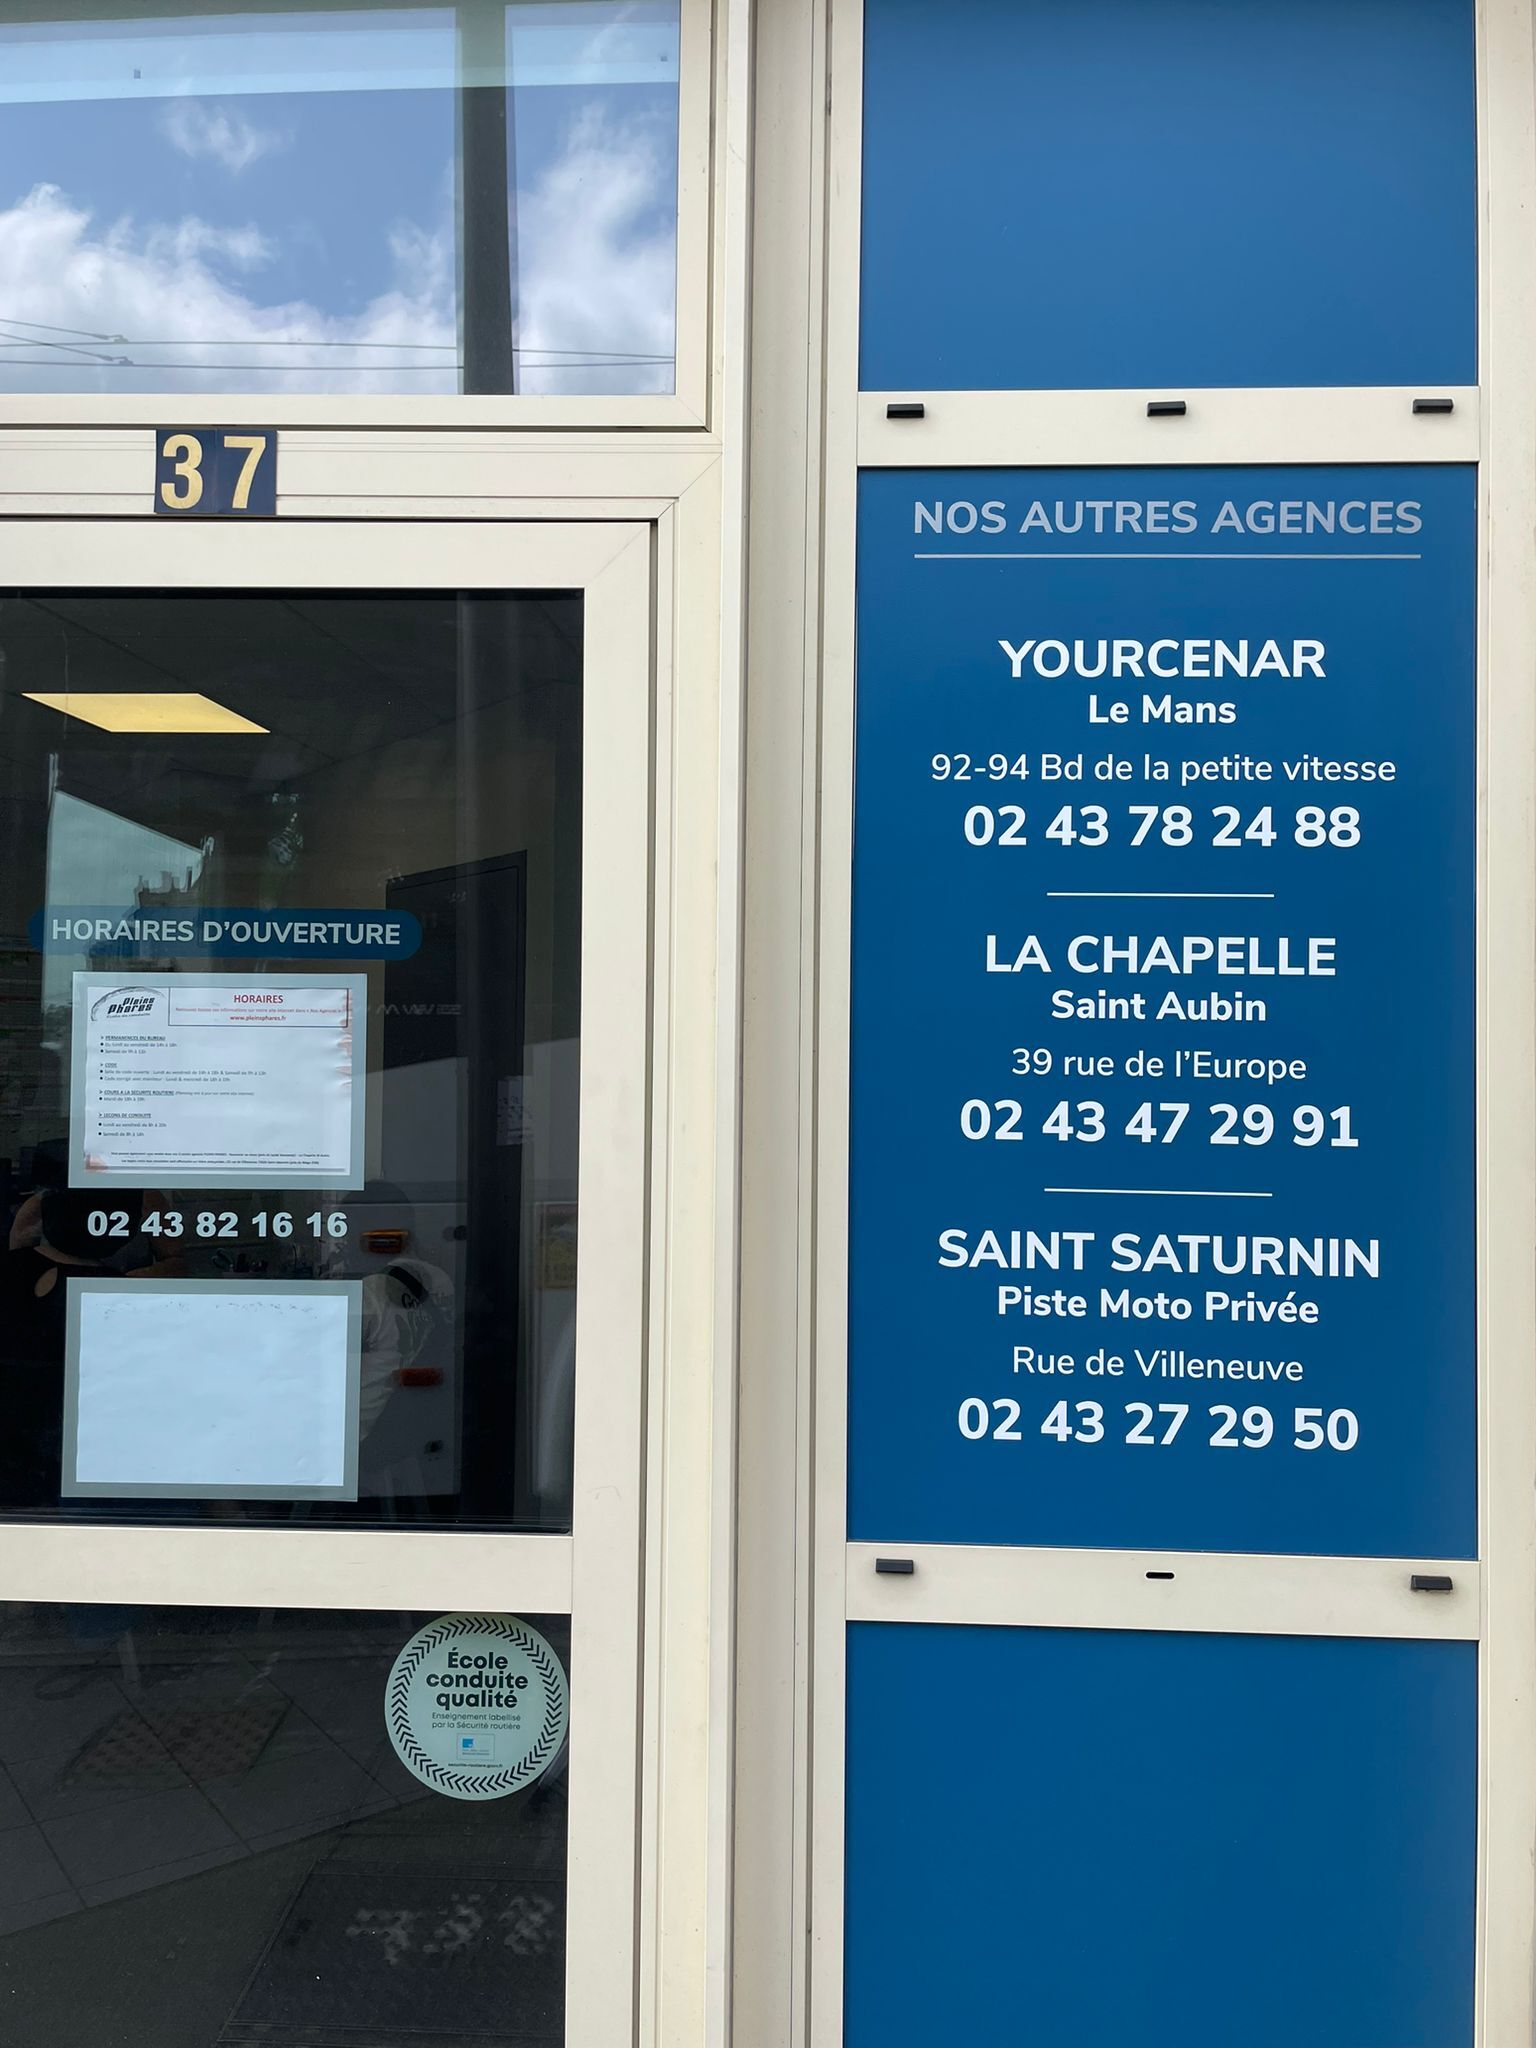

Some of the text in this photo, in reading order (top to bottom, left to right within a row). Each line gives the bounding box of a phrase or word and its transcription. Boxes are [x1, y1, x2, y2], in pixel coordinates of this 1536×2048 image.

[161, 434, 267, 510] 37
[914, 500, 1422, 534] NOS AUTRES AGENCES
[998, 639, 1327, 678] YOURCENAR
[1089, 694, 1237, 724] Le Mans
[931, 753, 1396, 787] 92-94 Bd de la petite vitesse
[964, 805, 1361, 848] 02 43 78 24 88
[52, 919, 401, 945] HORAIRES D’OUVERTURE
[986, 934, 1336, 976] LA CHAPELLE
[108, 1004, 152, 1014] Phares
[234, 995, 284, 1004] HORAIRES
[1051, 989, 1266, 1021] Saint Aubin
[1011, 1047, 1307, 1085] 39 rue de l’Europe
[960, 1098, 1359, 1147] 02 43 47 29 91
[87, 1210, 348, 1239] 02 43 82 16 16
[938, 1228, 1379, 1278] SAINT SATURNIN
[998, 1285, 1319, 1324] Piste Moto Privée
[1013, 1346, 1304, 1382] Rue de Villeneuve
[958, 1397, 1359, 1451] 02 43 27 29 50
[447, 1647, 509, 1670] École
[425, 1671, 529, 1689] conduite
[432, 1712, 521, 1721] Enseignement labellisé
[436, 1690, 518, 1711] qualité
